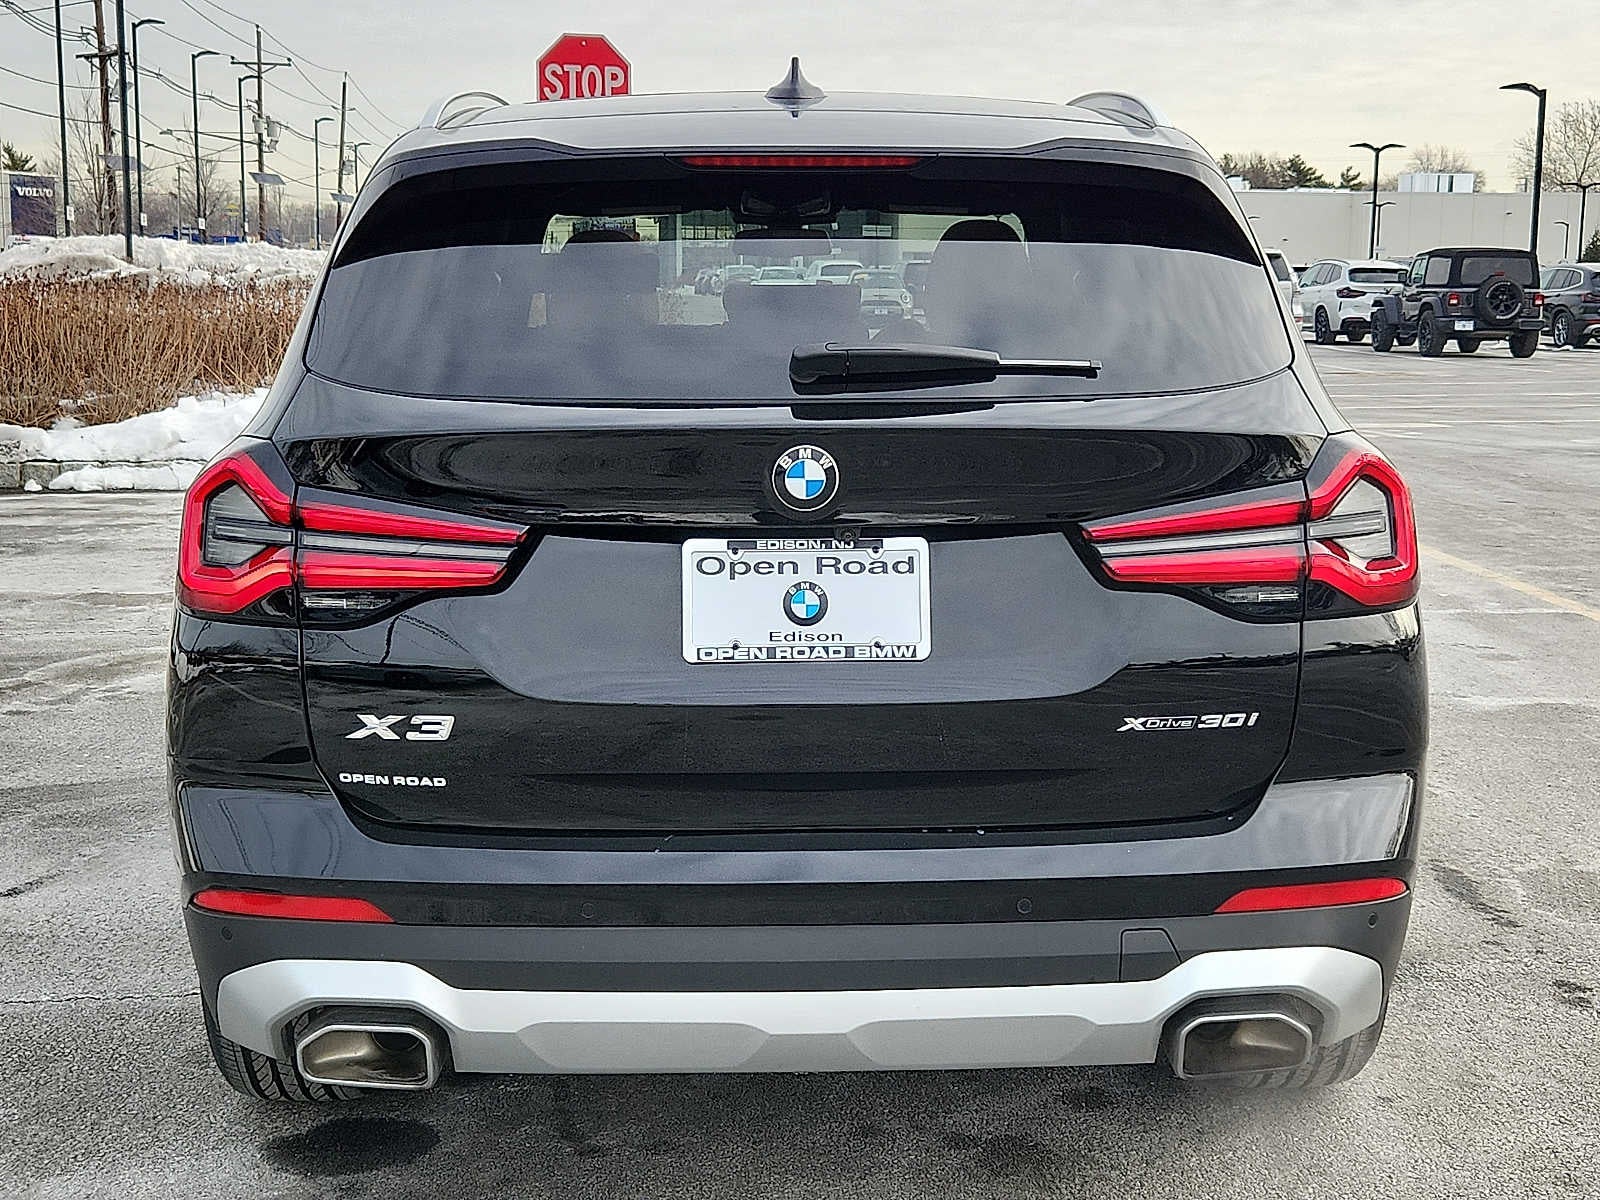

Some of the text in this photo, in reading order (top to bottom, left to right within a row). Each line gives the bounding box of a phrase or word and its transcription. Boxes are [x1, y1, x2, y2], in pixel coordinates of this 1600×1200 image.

[543, 63, 624, 100] STOP
[13, 184, 53, 197] VOLVO
[779, 448, 833, 470] BMW
[756, 540, 854, 550] EDISON, NJ
[696, 556, 915, 580] Open Road
[788, 582, 824, 596] BMW
[769, 631, 843, 642] Edison
[699, 646, 917, 660] OPEN ROAD BMW
[344, 714, 455, 740] X3
[339, 773, 447, 787] OPEN ROAD
